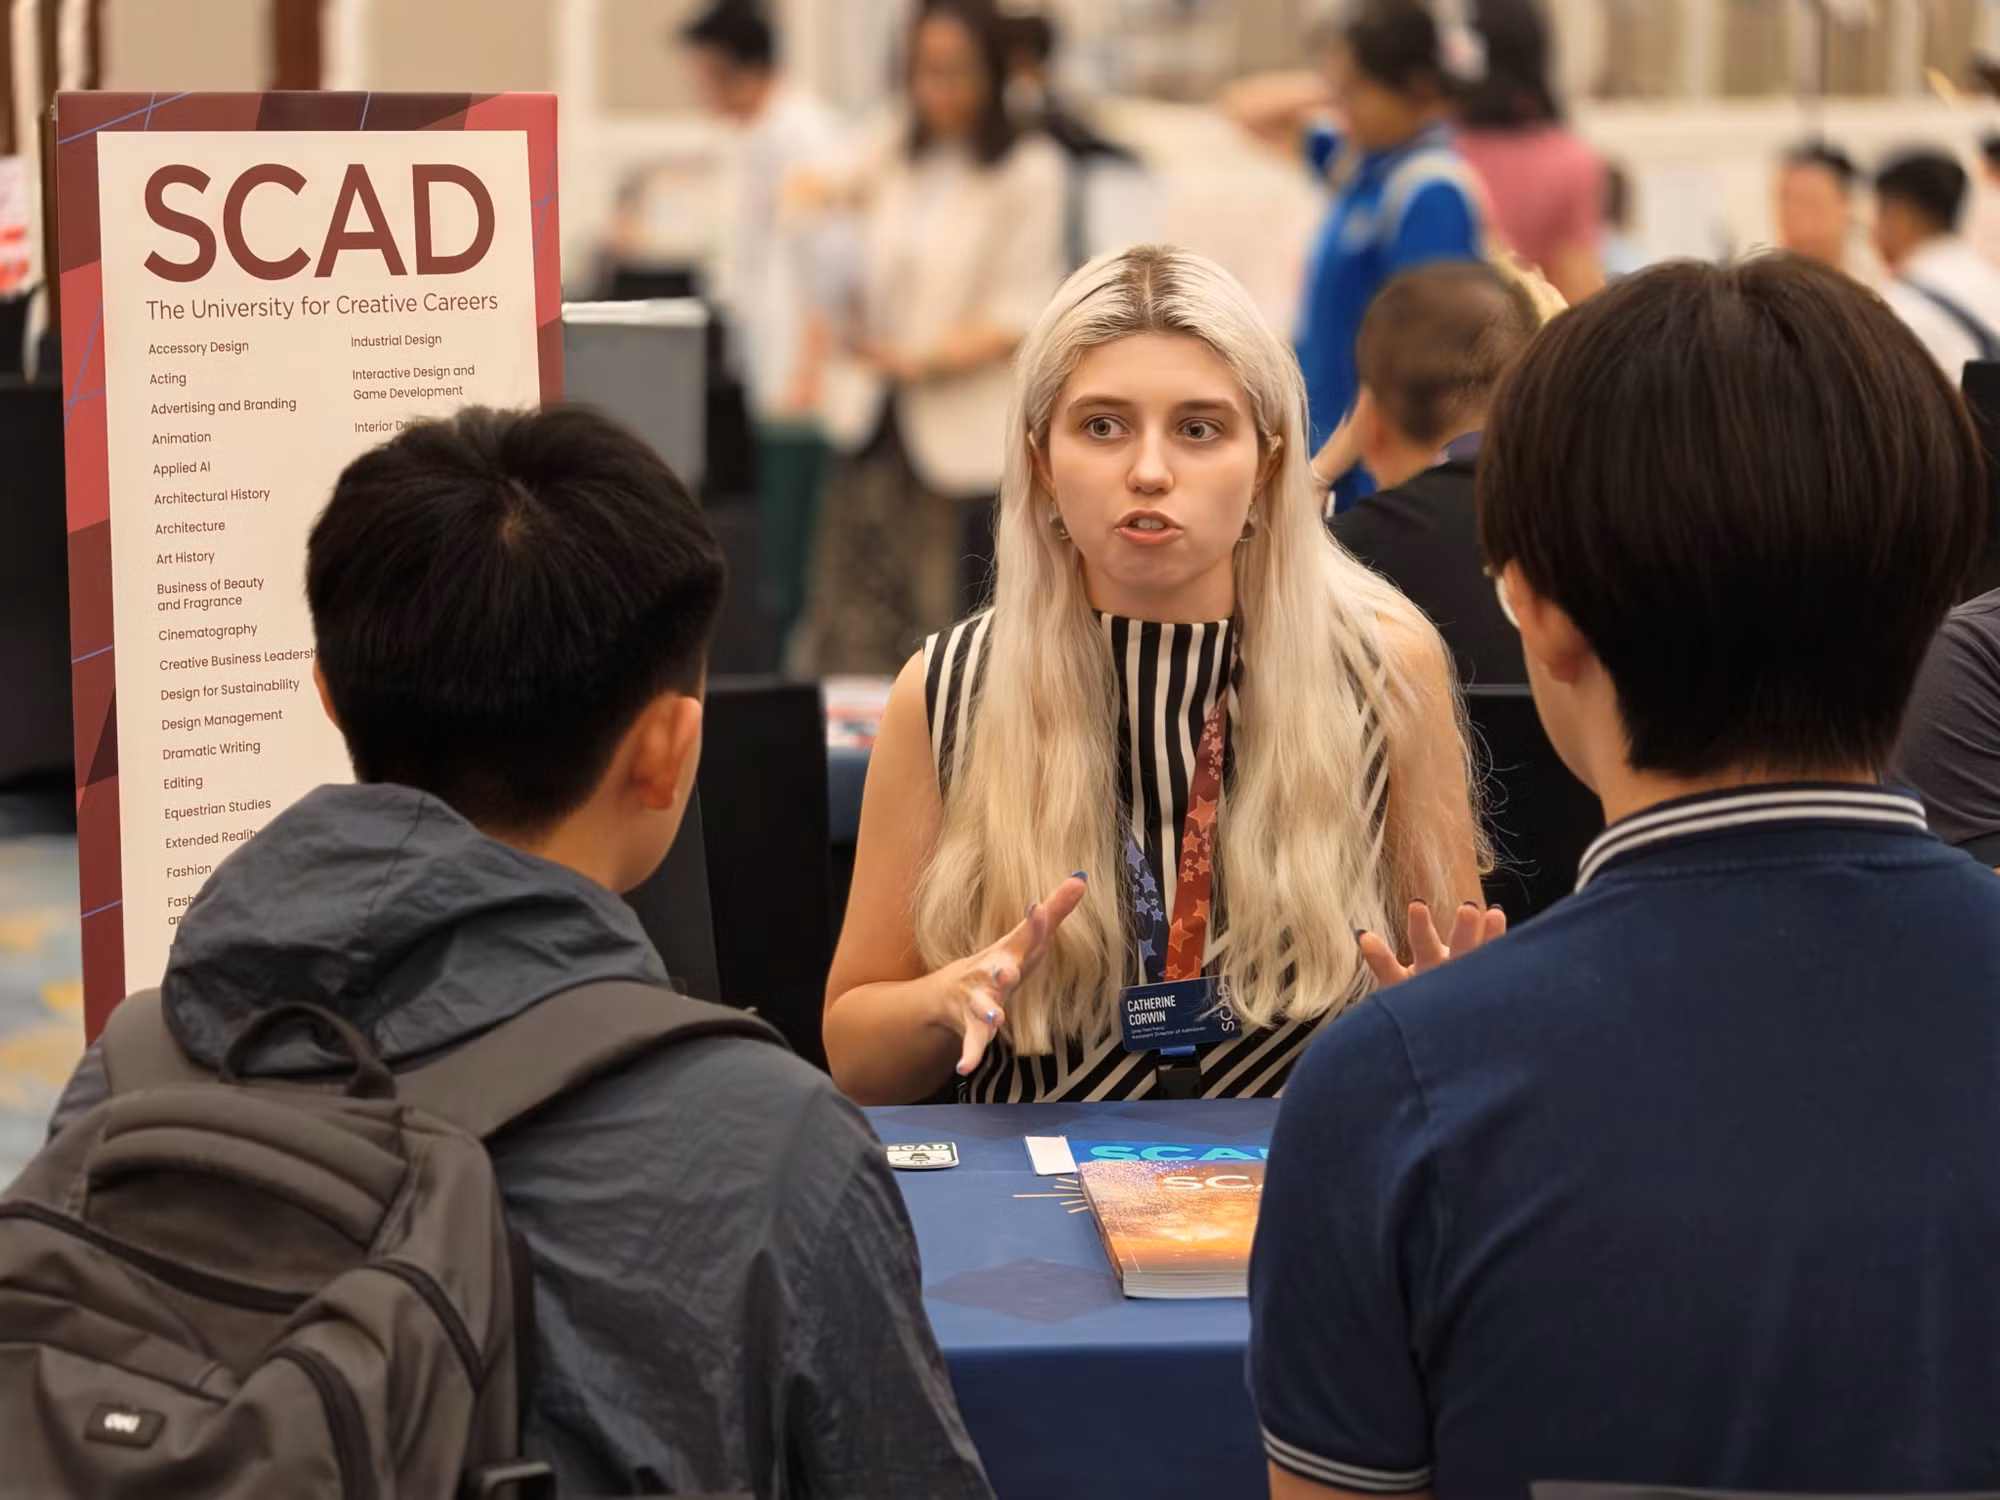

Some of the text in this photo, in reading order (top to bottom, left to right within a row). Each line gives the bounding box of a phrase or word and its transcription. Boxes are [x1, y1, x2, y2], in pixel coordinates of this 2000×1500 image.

[143, 163, 496, 283] SCAD
[145, 292, 499, 321] The University for Creative Careers
[148, 339, 250, 357] Accessory Design
[350, 333, 443, 349] Industrial Design
[149, 372, 187, 388] Acting
[352, 364, 476, 381] Interactive Design and
[352, 384, 464, 401] Game Development
[150, 397, 297, 416] Advertising and Branding
[354, 420, 394, 433] Interior
[151, 431, 212, 445] Animation
[152, 460, 211, 479] Applied AI
[153, 488, 271, 506] Architectural History
[154, 521, 226, 536] Architecture
[156, 551, 216, 566] Art History
[156, 576, 265, 595] Business of Beauty
[157, 596, 243, 612] and Fragrance
[158, 623, 258, 641] Cinematography
[159, 647, 318, 671] Creative Business Leadersh
[160, 677, 300, 703] Design for Sustainability
[161, 709, 284, 732] Design Management
[162, 740, 261, 761] Dramatic Writing
[163, 775, 204, 790] Editing
[164, 799, 272, 821] Equestrian Studies
[165, 832, 219, 849] Extended
[166, 863, 212, 879] Fashion
[1127, 995, 1176, 1012] CATHERINE
[1128, 1011, 1166, 1026] CORWIN
[1154, 1029, 1174, 1037] Director
